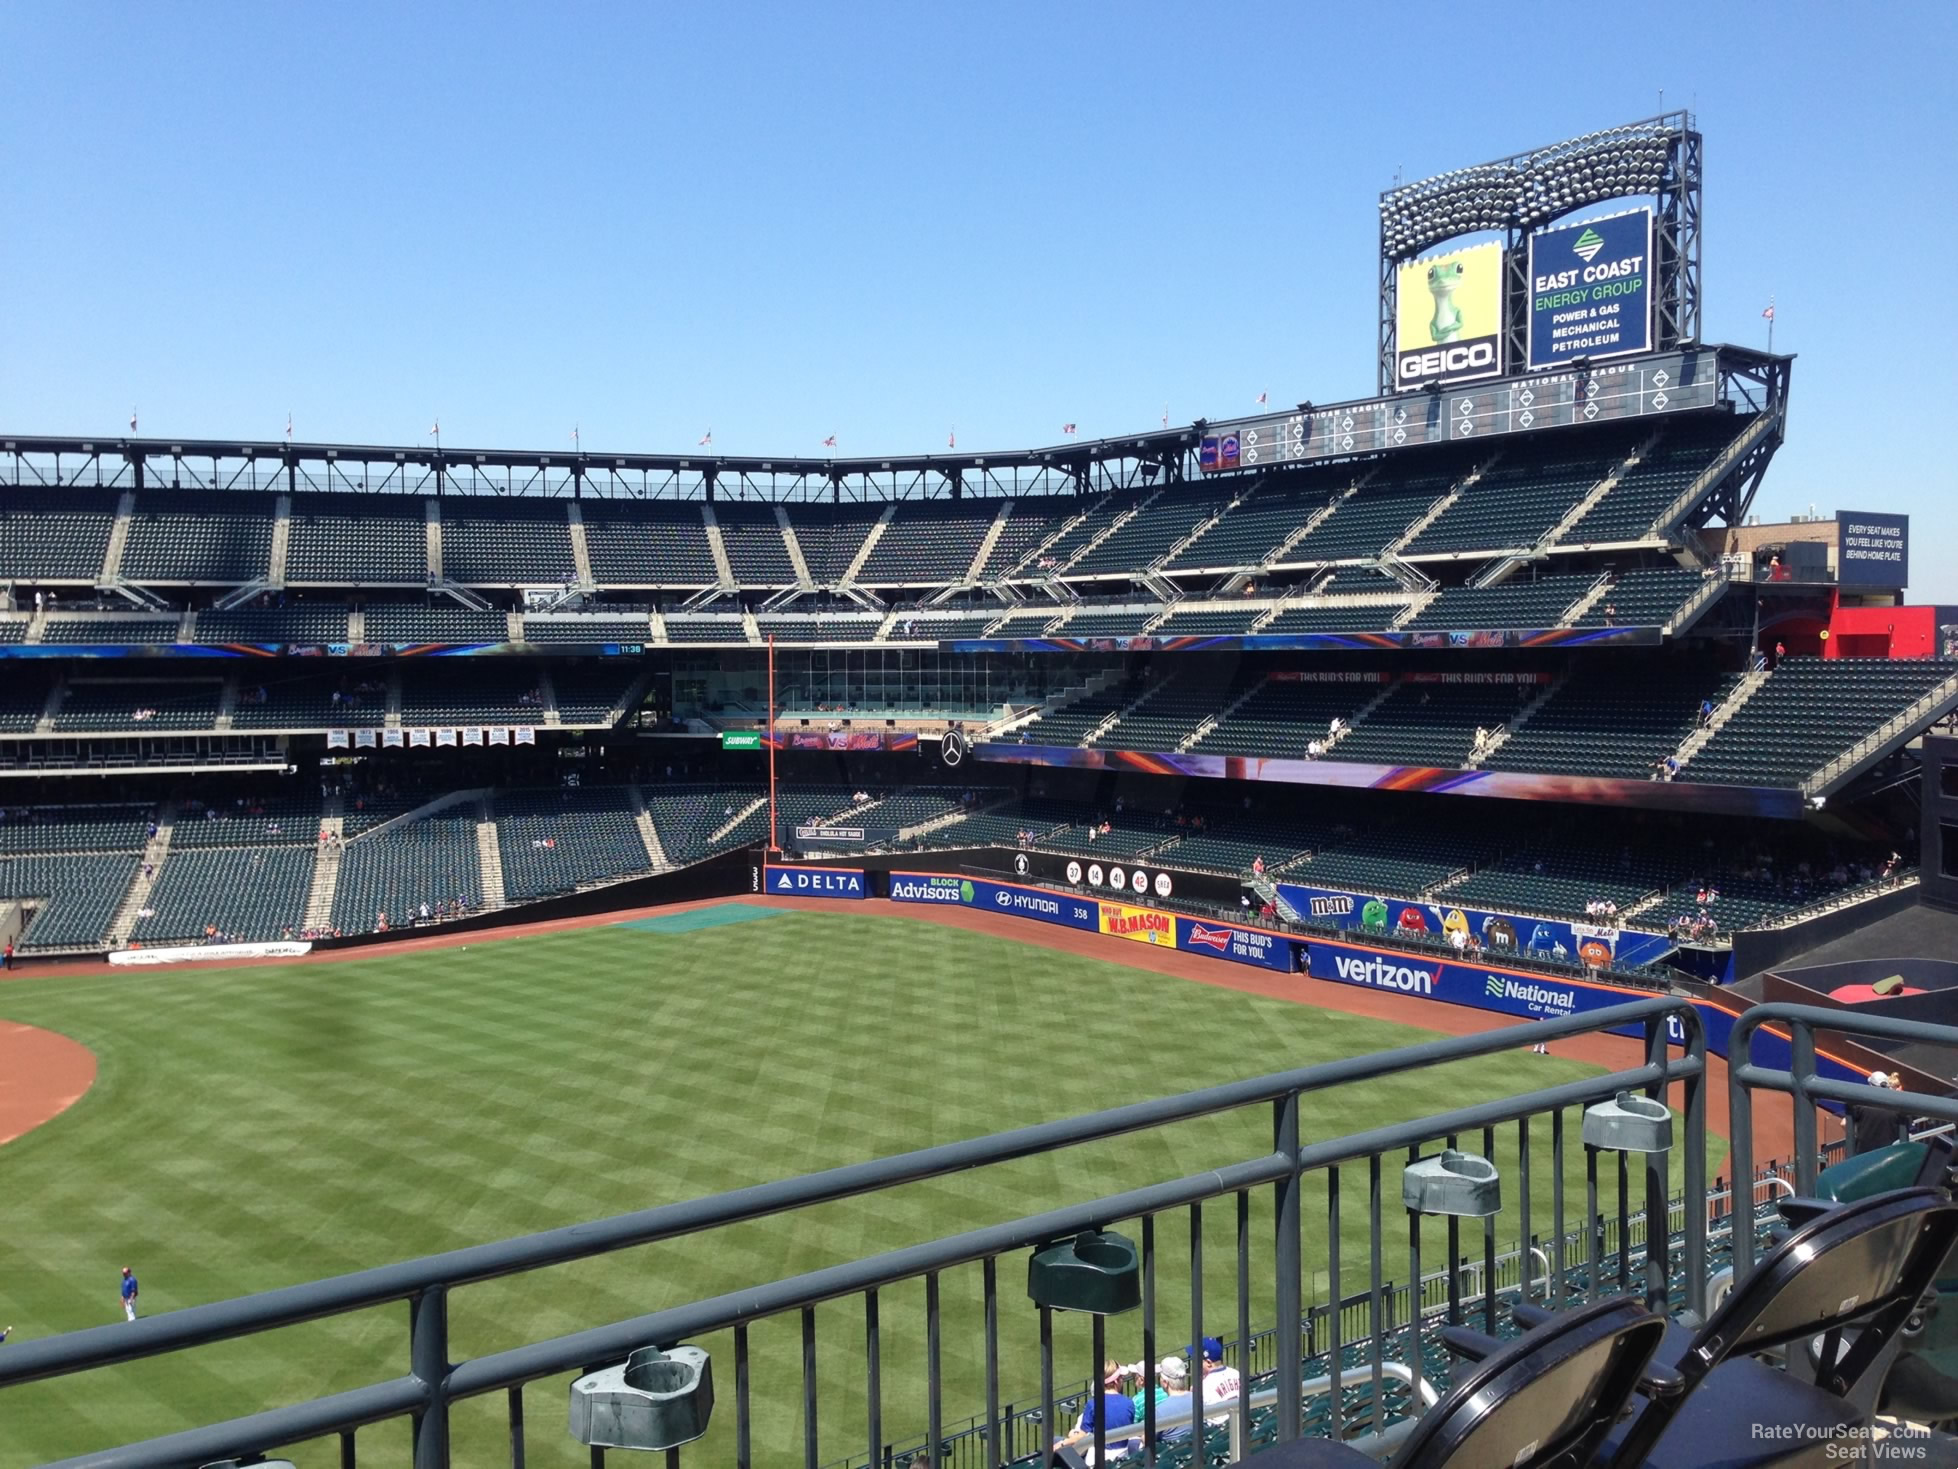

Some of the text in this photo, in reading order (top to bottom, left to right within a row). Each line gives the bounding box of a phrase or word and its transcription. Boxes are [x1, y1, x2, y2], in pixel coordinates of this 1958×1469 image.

[1536, 256, 1643, 293] EAST COAST
[1536, 279, 1642, 311] ENERGY GROUP
[1553, 304, 1620, 324] POWER & GAS
[1553, 319, 1620, 338] MECHANICAL
[1552, 333, 1620, 352] PETROLEUM
[1400, 342, 1493, 379] GEICO
[1511, 364, 1636, 389] NATIONAL LEAGUE
[1289, 403, 1386, 423] AMERICAN LEAGUE
[1848, 524, 1900, 536] EVERY SEAT MAKES
[1845, 537, 1903, 549] YOU FEEL LIKE YOU'RE
[1846, 550, 1867, 559] BEHIND
[1867, 551, 1884, 560] HOME
[1450, 635, 1467, 644] VS
[328, 646, 346, 655] VS
[1300, 672, 1317, 683] THIS
[1319, 672, 1344, 683] BUD'S
[1345, 672, 1362, 683] FOR
[1363, 672, 1380, 683] YOU
[1441, 673, 1461, 683] THIS
[1464, 673, 1493, 684] BUD'S
[1495, 673, 1514, 684] FOR
[1516, 673, 1537, 684] YOU
[725, 736, 757, 745] SUBWAY
[827, 737, 848, 748] VS
[1070, 867, 1079, 878] 37
[1091, 870, 1099, 881] 14
[1113, 873, 1121, 884] 41
[798, 874, 860, 891] DELTA
[930, 877, 959, 887] BLOCK
[1134, 876, 1145, 888] 42
[1157, 880, 1170, 889] SHEA
[892, 882, 960, 901] Advisors
[1014, 895, 1059, 915] HYUNDAI
[1074, 907, 1088, 920] 358
[1192, 927, 1229, 944] Budweiser
[1233, 930, 1272, 948] THIS BUD'S
[1233, 943, 1265, 960] FOR YOU.
[1335, 955, 1432, 994] verizon
[1528, 1003, 1542, 1013] Car
[1215, 1378, 1240, 1398] WRIGH
